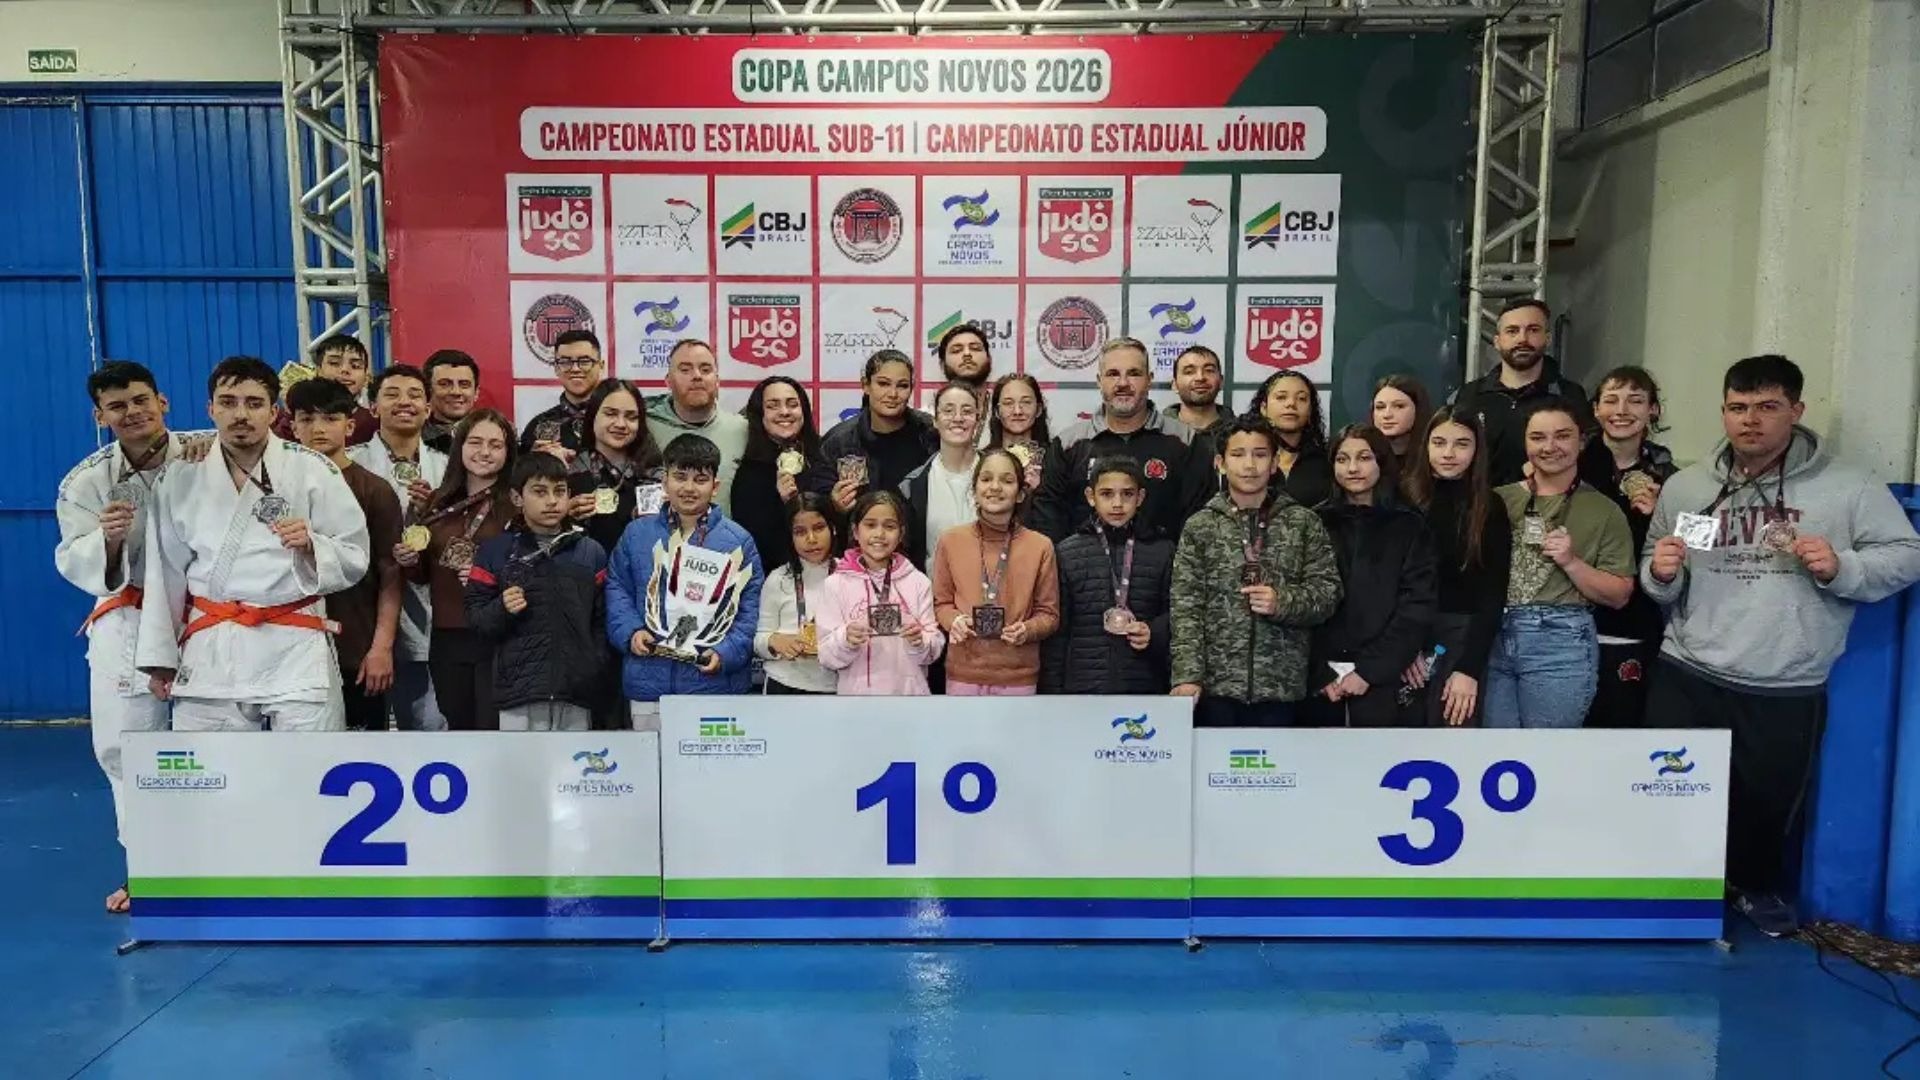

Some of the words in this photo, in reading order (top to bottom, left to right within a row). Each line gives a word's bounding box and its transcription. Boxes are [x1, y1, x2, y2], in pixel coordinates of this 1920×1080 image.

[30, 54, 77, 70] SAÍDA
[739, 58, 809, 93] COPA
[817, 58, 929, 93] CAMPOS
[938, 58, 1027, 93] NOVOS
[1035, 57, 1104, 93] 2026
[539, 121, 697, 153] CAMPEONATO
[703, 122, 821, 154] ESTADUAL
[827, 123, 905, 154] SUB-11
[925, 122, 1084, 154] CAMPEONATO
[1091, 121, 1209, 153] ESTADUAL
[1217, 114, 1306, 152] JÚNIOR
[758, 212, 806, 232] CBJ
[1284, 211, 1334, 232] CBJ
[759, 234, 806, 242] BRASIL
[946, 239, 995, 249] CAMPOS
[1284, 234, 1332, 242] BRASIL
[950, 251, 990, 260] NOVOS
[319, 762, 468, 866] 2º
[856, 762, 997, 866] 1º
[1377, 759, 1537, 866] 3º
